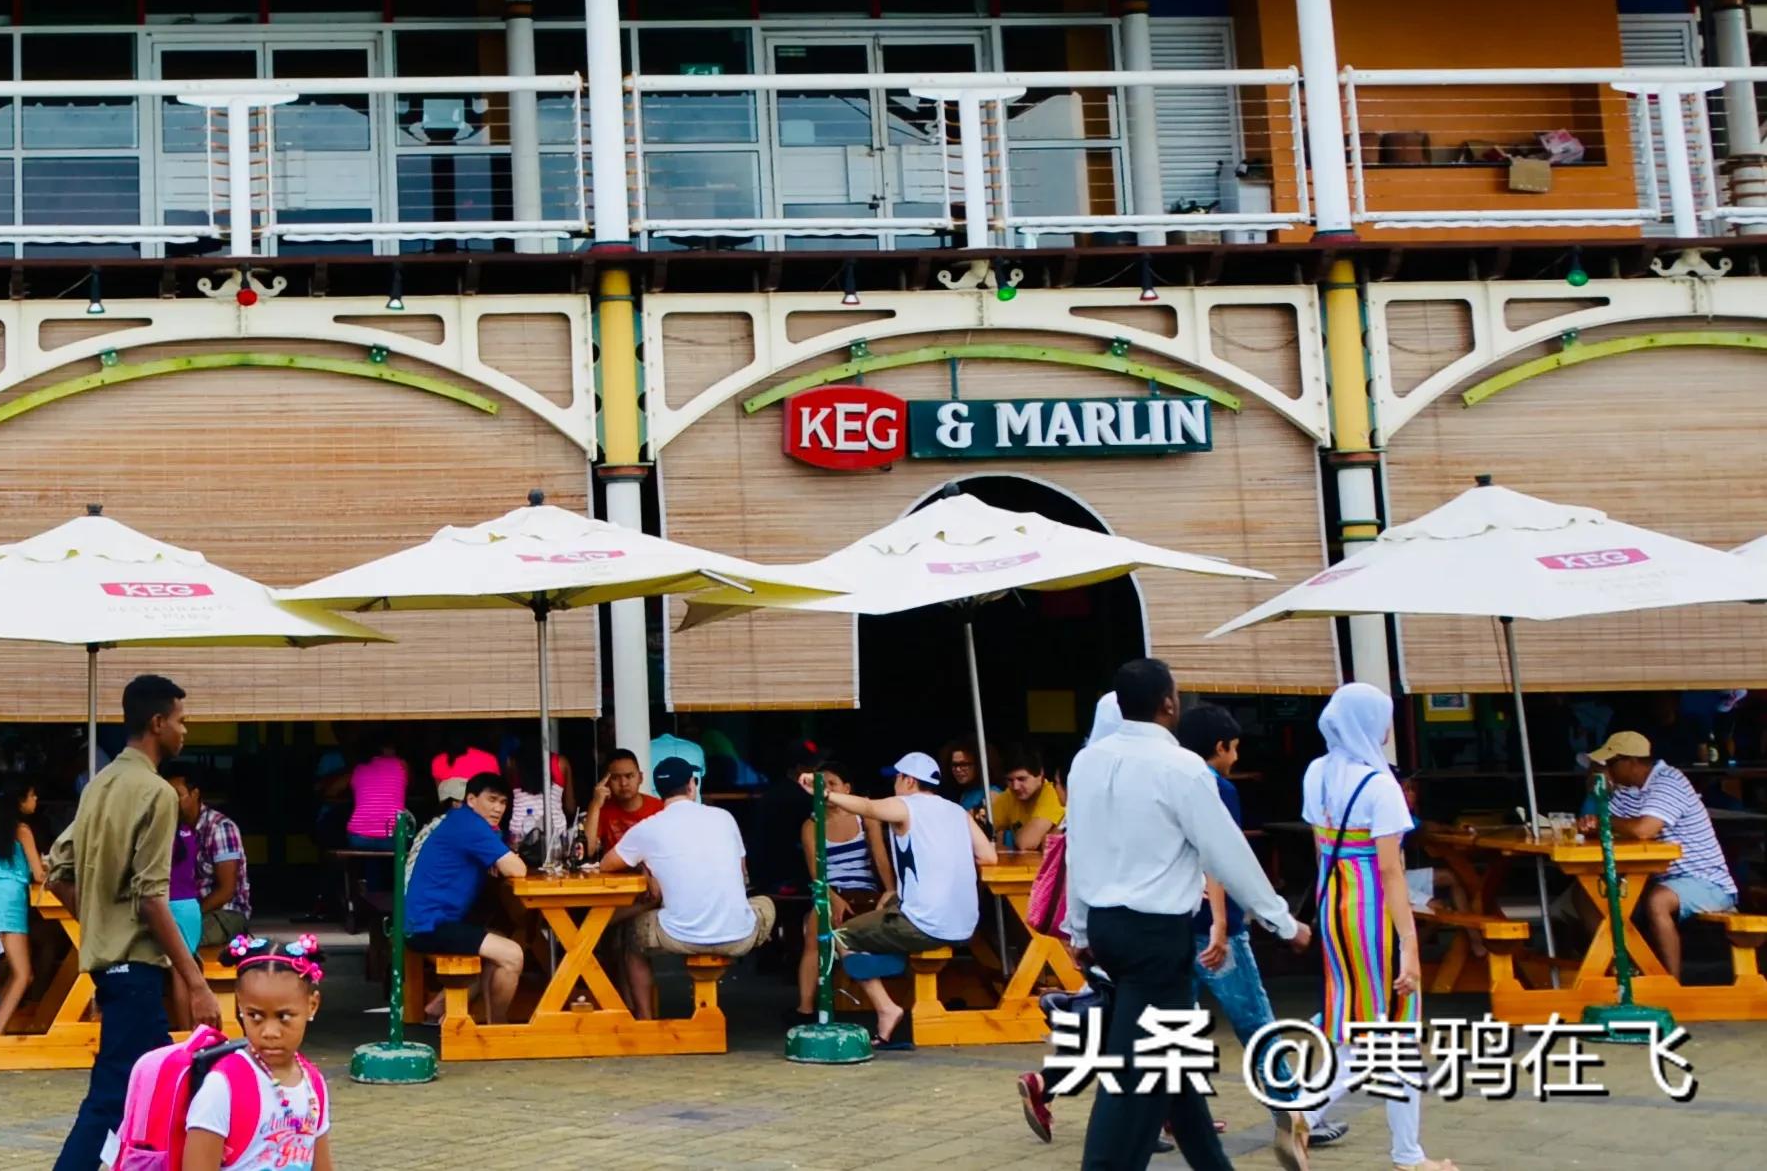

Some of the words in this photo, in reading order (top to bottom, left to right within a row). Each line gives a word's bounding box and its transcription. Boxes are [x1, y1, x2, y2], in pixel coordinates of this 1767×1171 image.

[799, 402, 899, 451] KEG
[936, 401, 976, 449] &
[995, 398, 1208, 448] MARLIN
[950, 557, 1022, 573] KEG
[1555, 551, 1630, 568] KEG
[119, 583, 195, 597] KEG
